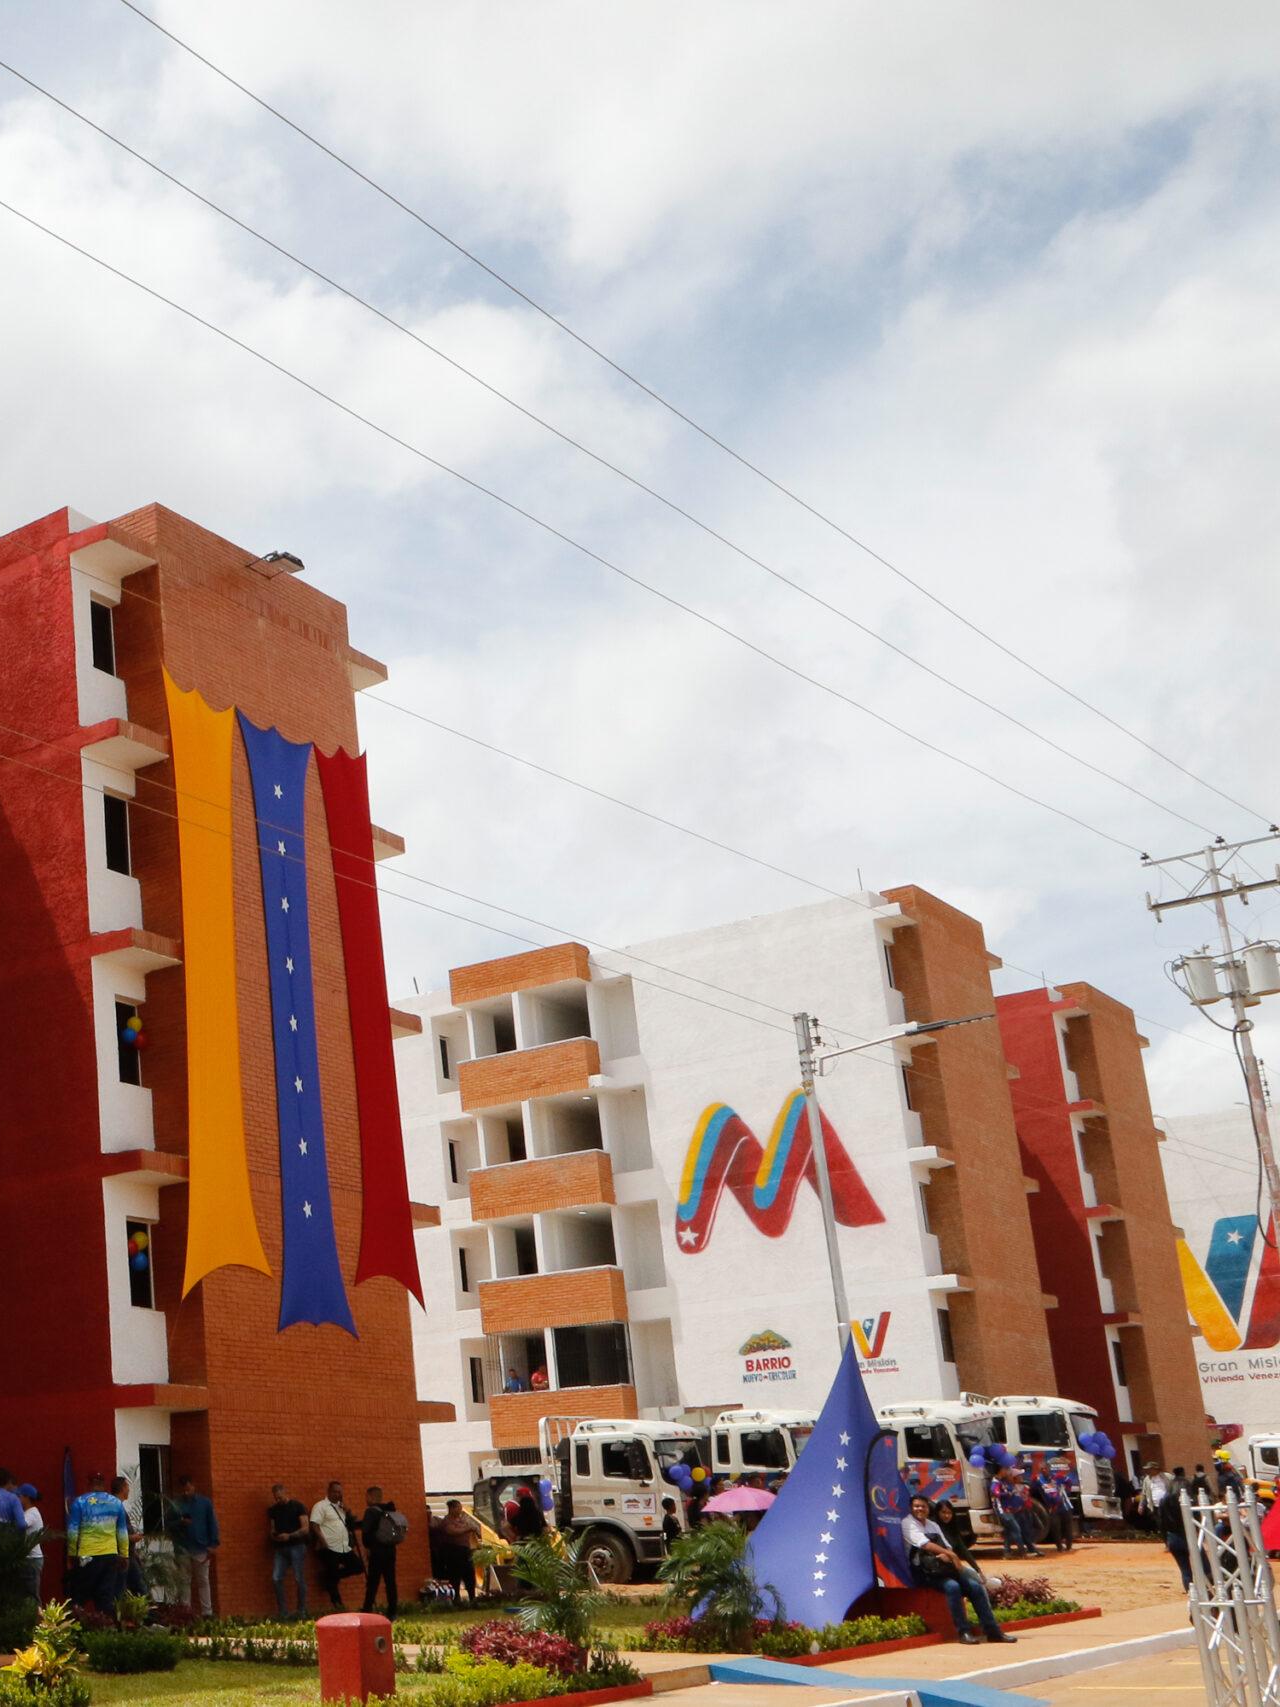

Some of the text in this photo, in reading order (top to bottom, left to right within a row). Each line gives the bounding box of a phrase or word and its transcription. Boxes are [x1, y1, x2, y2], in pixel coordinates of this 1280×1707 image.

[745, 1356, 791, 1372] BARRIO
[1198, 1356, 1280, 1373] Gran Misi
[1201, 1372, 1280, 1383] Vivienda Venez
